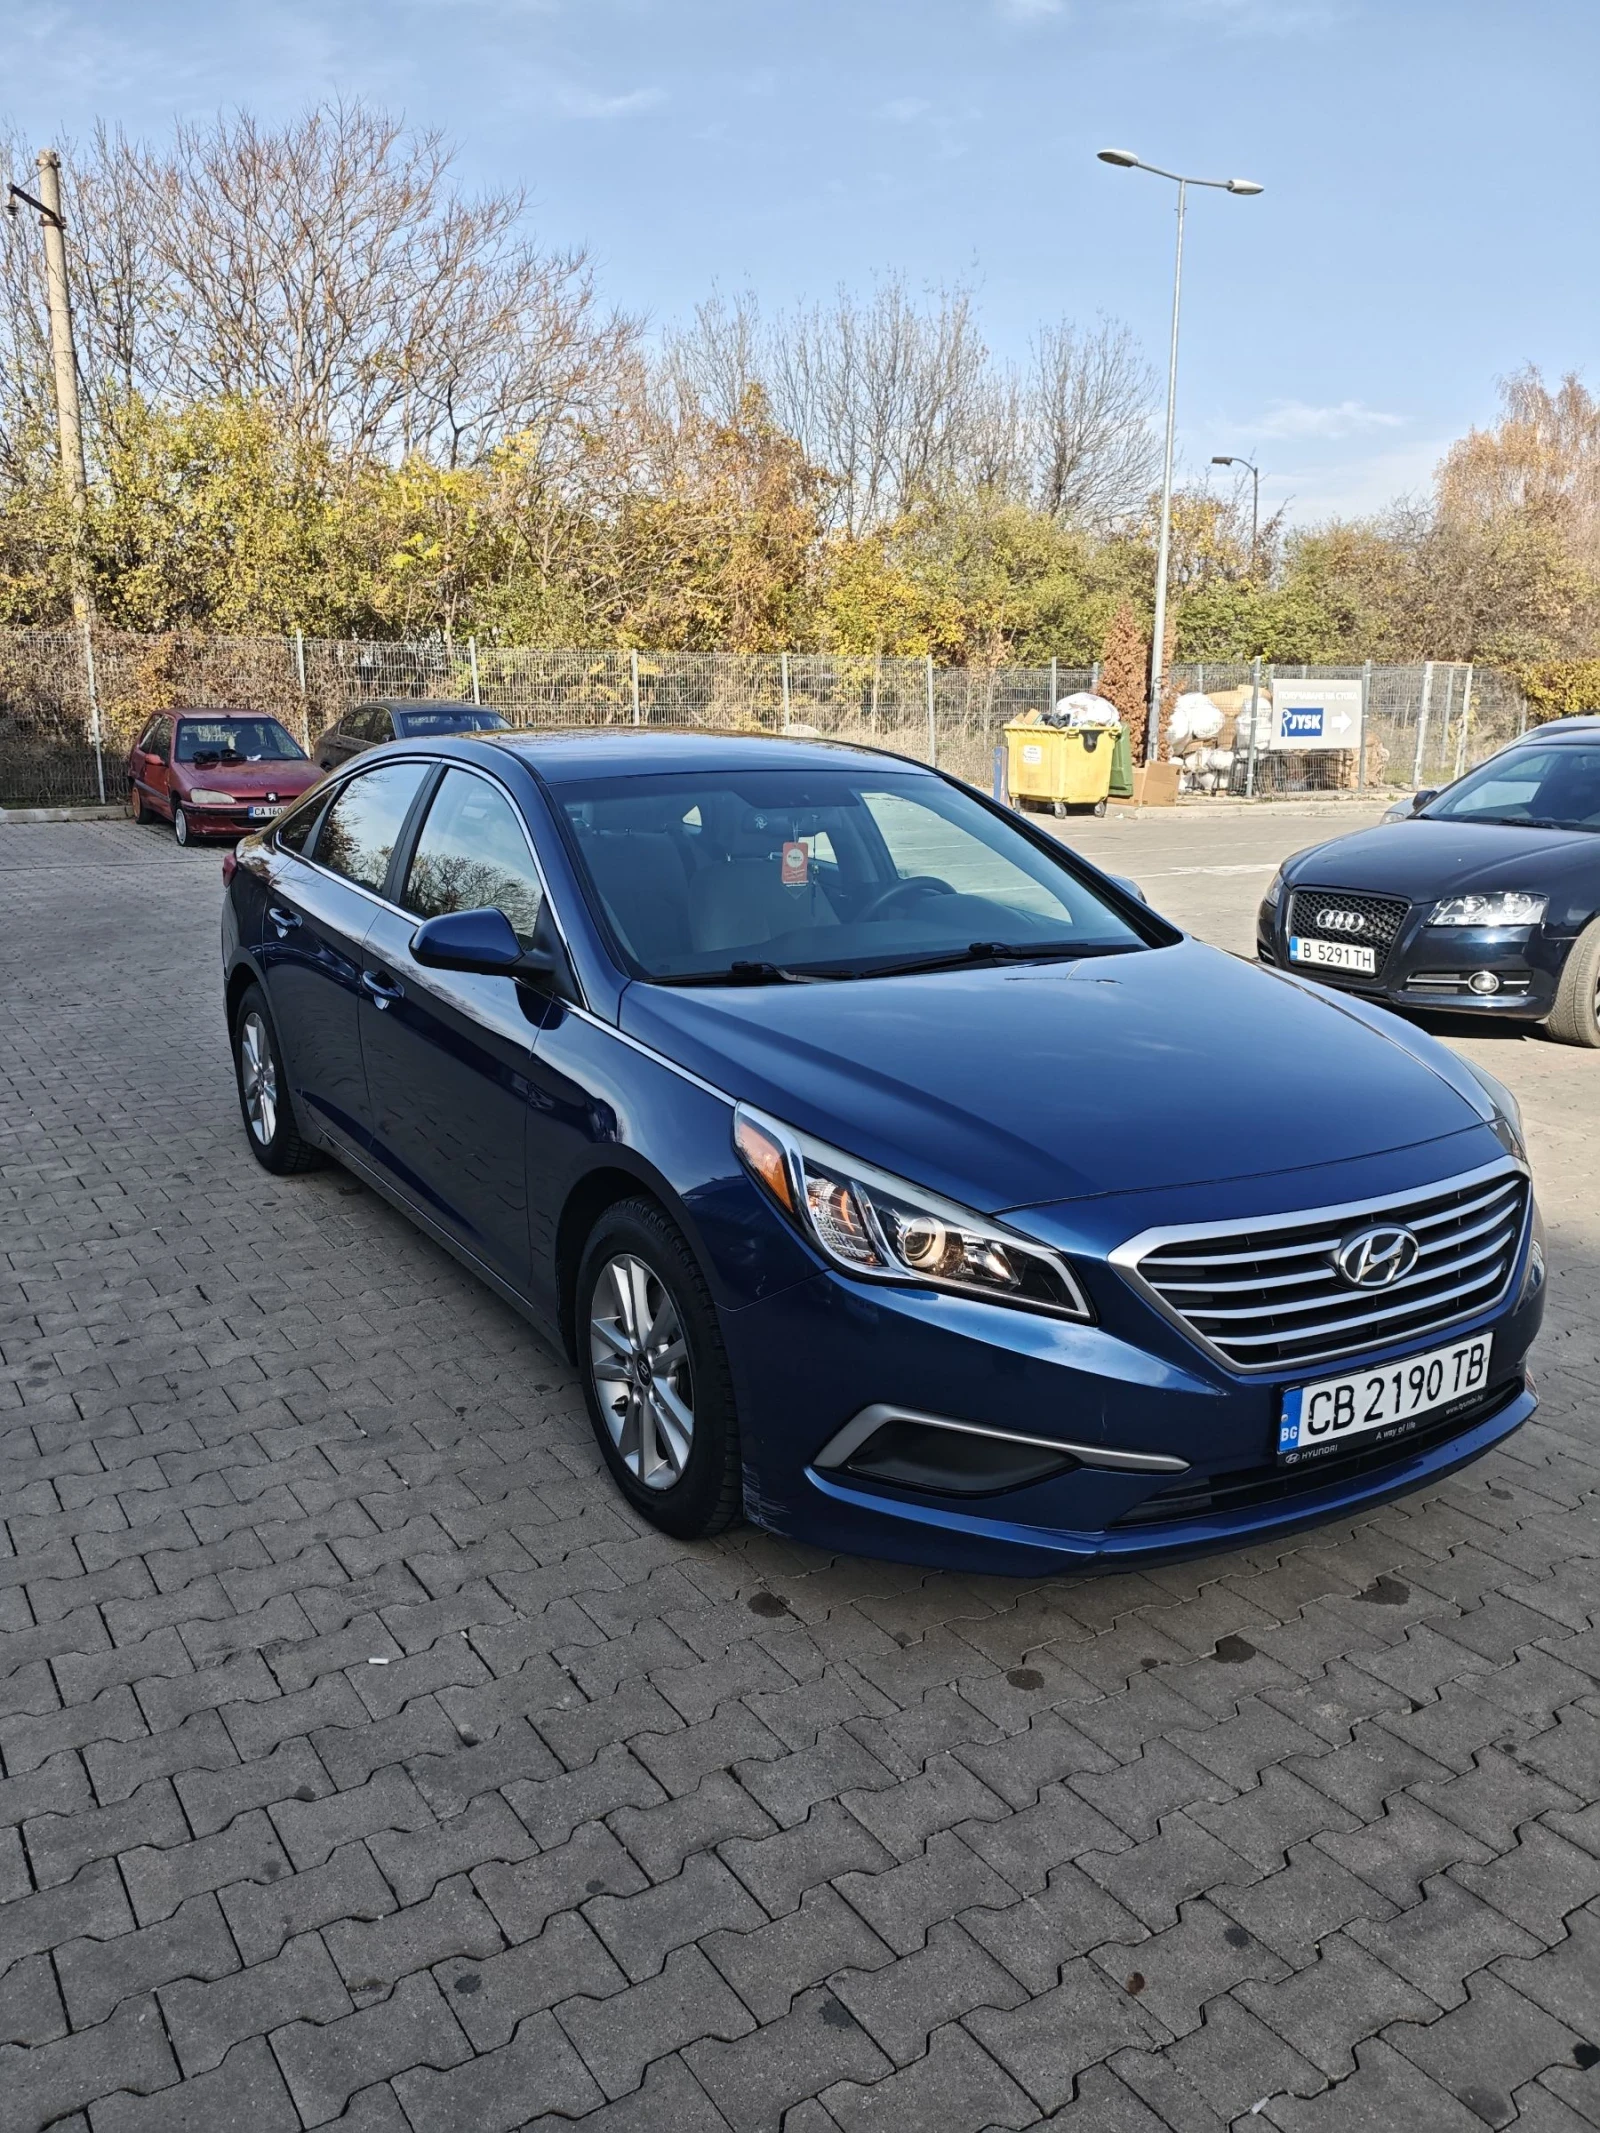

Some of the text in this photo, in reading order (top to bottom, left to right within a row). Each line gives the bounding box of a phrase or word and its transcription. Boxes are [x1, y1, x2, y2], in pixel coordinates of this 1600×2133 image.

[1289, 714, 1322, 730] JYSK
[255, 807, 265, 816] CA
[1303, 942, 1372, 968] B 5291 TH
[1307, 1343, 1485, 1435] CB 2190 TB
[1281, 1426, 1298, 1442] BG
[1375, 1421, 1416, 1440] A way of life
[1301, 1444, 1338, 1460] HYUNDAI
